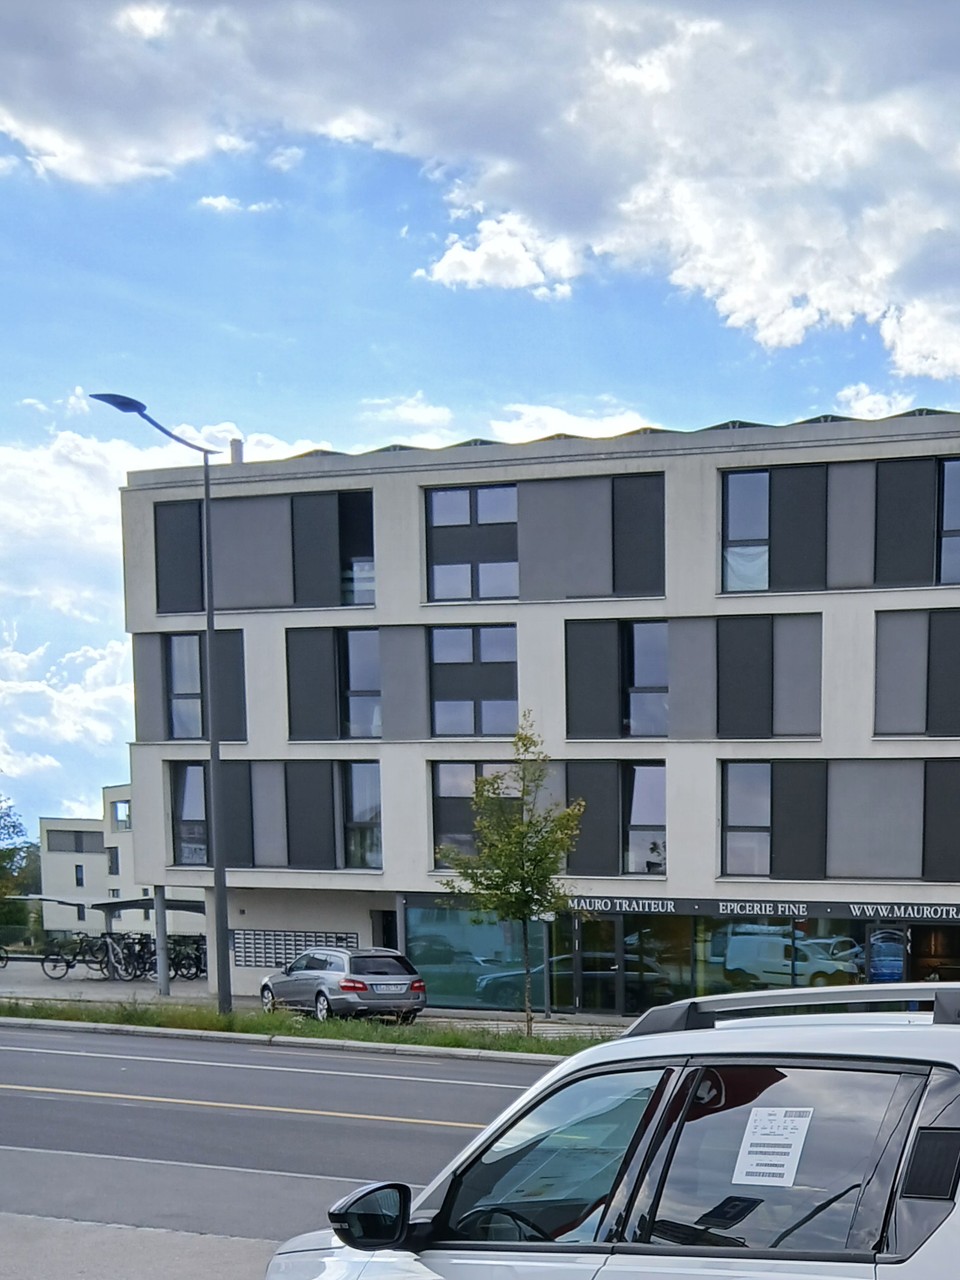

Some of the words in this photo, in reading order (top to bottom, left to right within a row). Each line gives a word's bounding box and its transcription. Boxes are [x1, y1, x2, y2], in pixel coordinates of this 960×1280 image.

[568, 898, 611, 911] MAURO
[614, 899, 676, 913] TRAITEUR
[718, 902, 775, 915] EPICERIE
[777, 903, 808, 916] FINE
